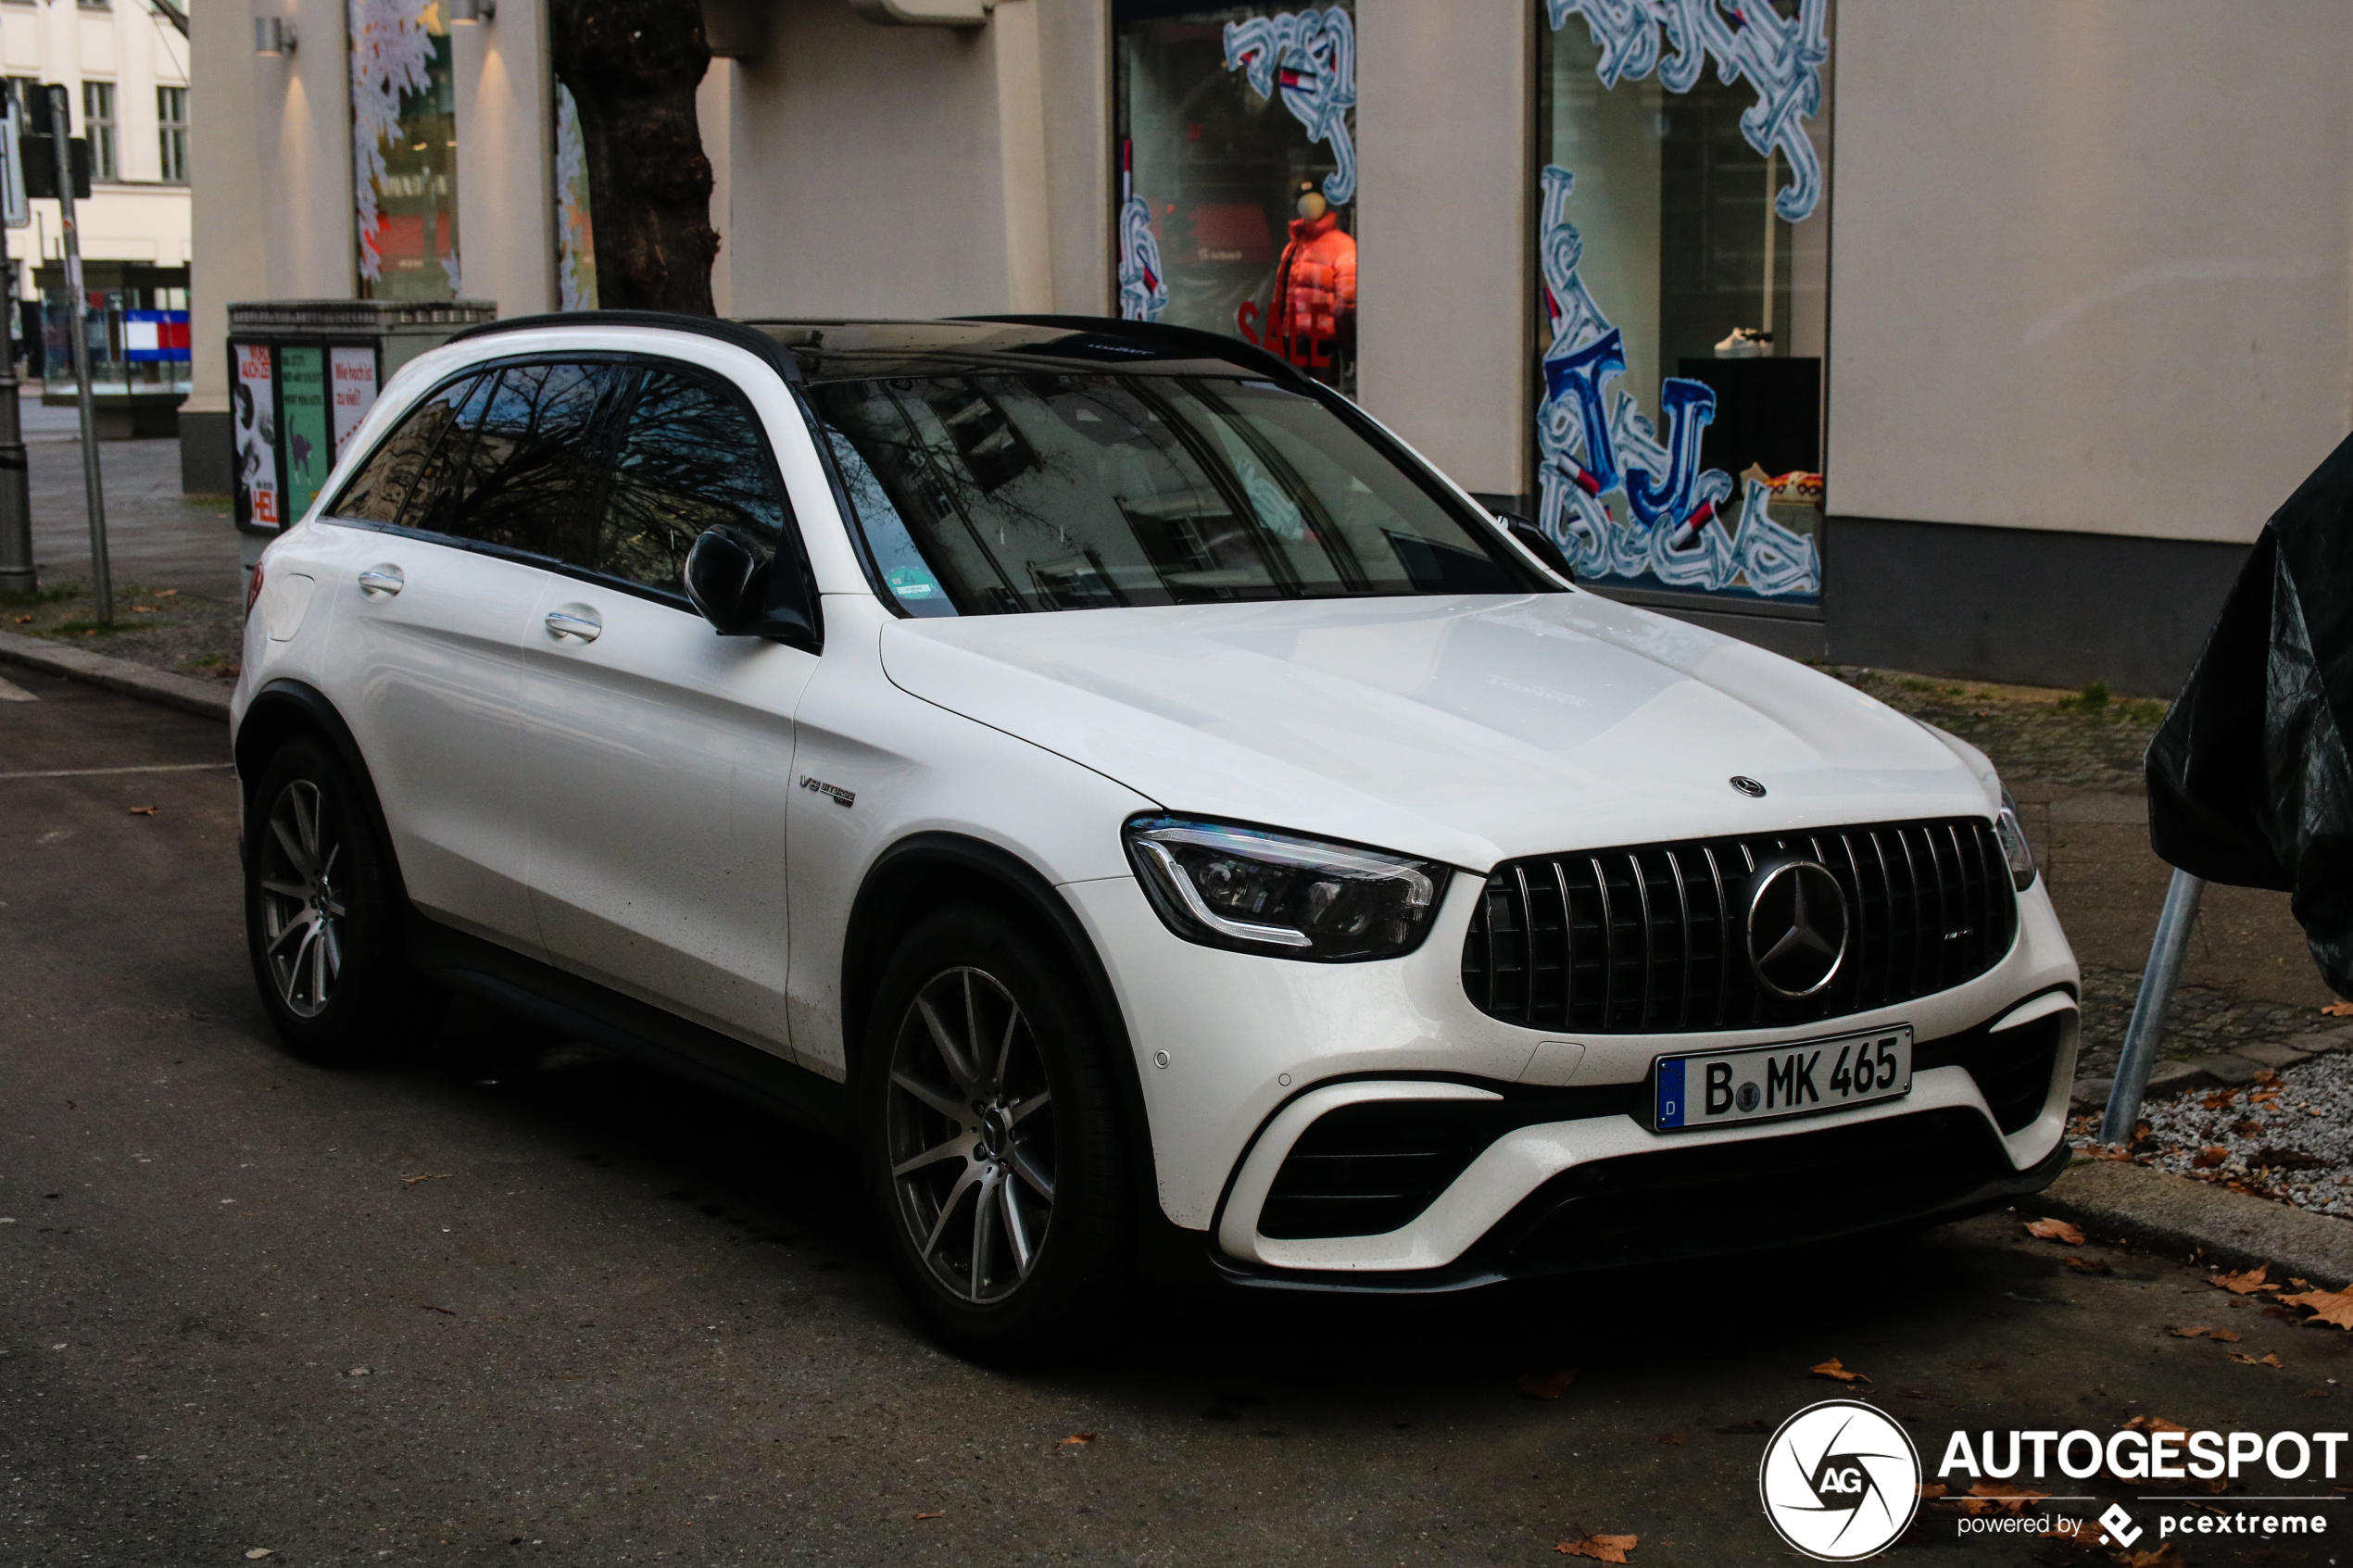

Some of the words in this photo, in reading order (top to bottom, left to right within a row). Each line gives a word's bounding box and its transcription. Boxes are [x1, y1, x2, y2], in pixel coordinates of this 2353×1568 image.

[1238, 301, 1331, 368] SALE
[348, 362, 364, 381] hoch
[799, 774, 821, 792] V8
[1705, 1061, 1733, 1115] B
[1767, 1049, 1821, 1109] MK
[1830, 1036, 1898, 1097] 465
[1666, 1100, 1676, 1116] D
